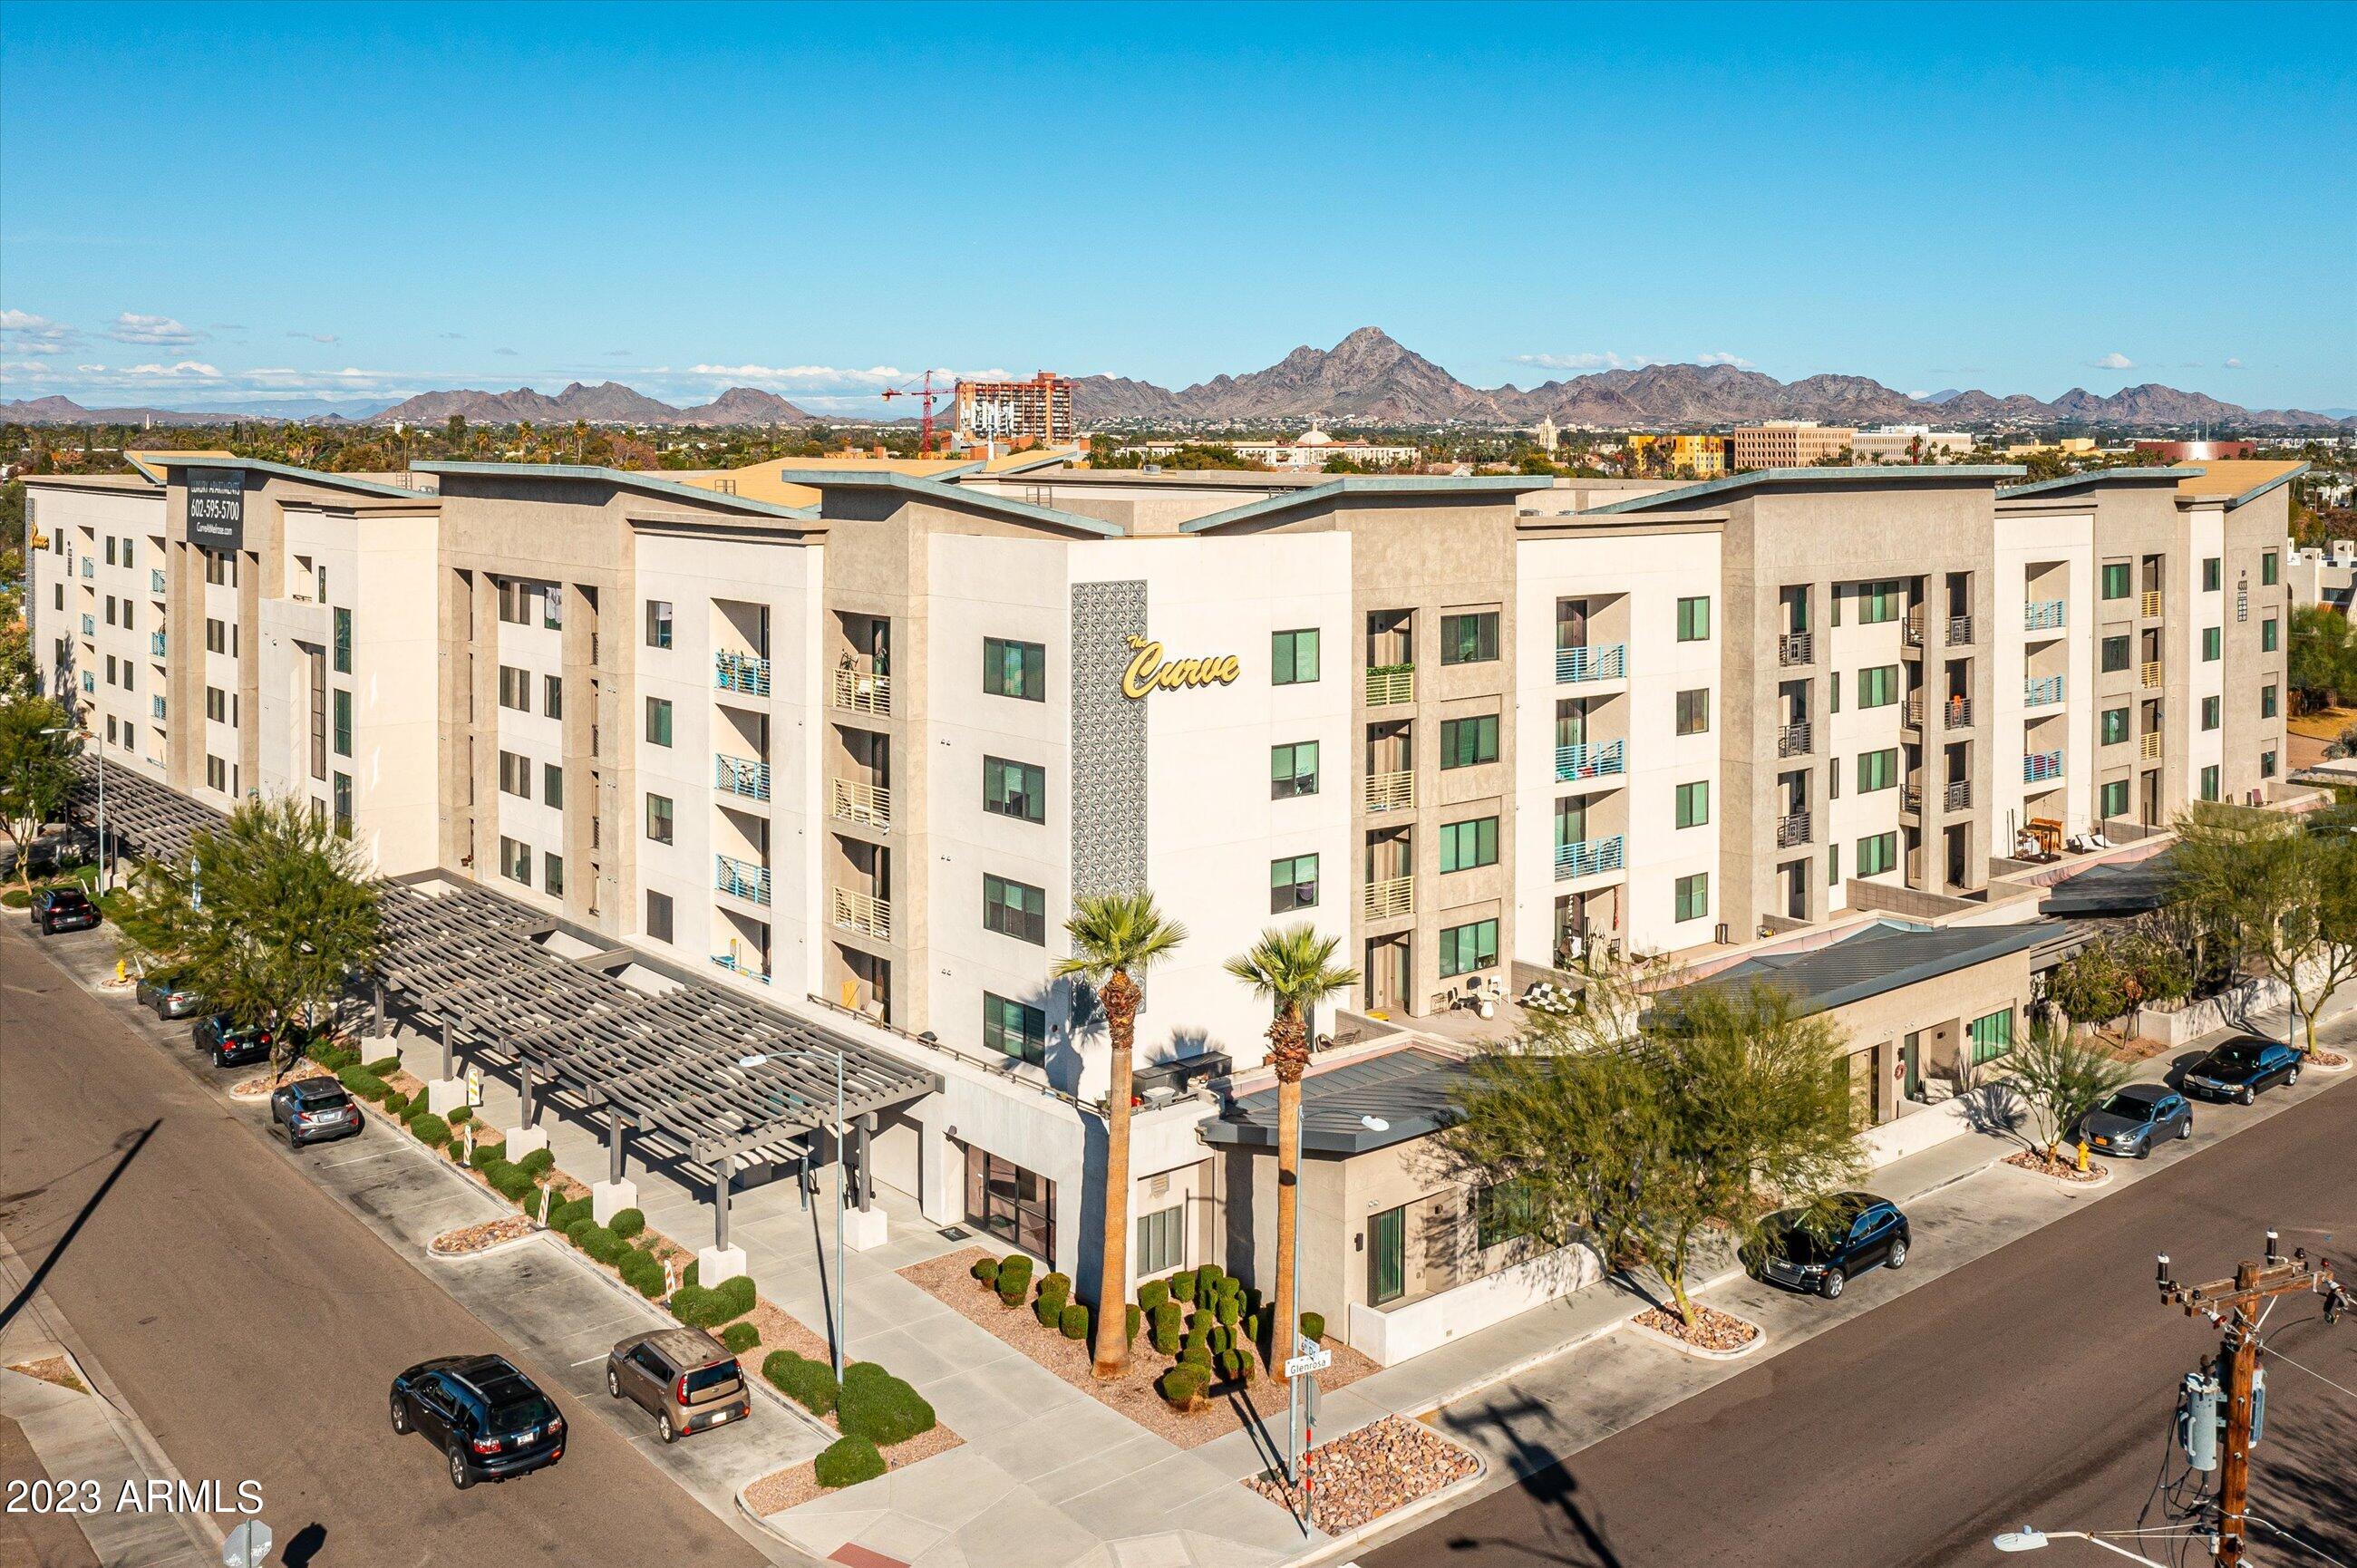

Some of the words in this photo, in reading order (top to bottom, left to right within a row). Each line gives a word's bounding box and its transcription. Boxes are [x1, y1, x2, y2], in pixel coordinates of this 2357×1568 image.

[191, 499, 239, 520] 602-595-5700
[1126, 634, 1148, 649] The
[1121, 641, 1241, 700] Curve
[1290, 1359, 1326, 1375] Glenrosa
